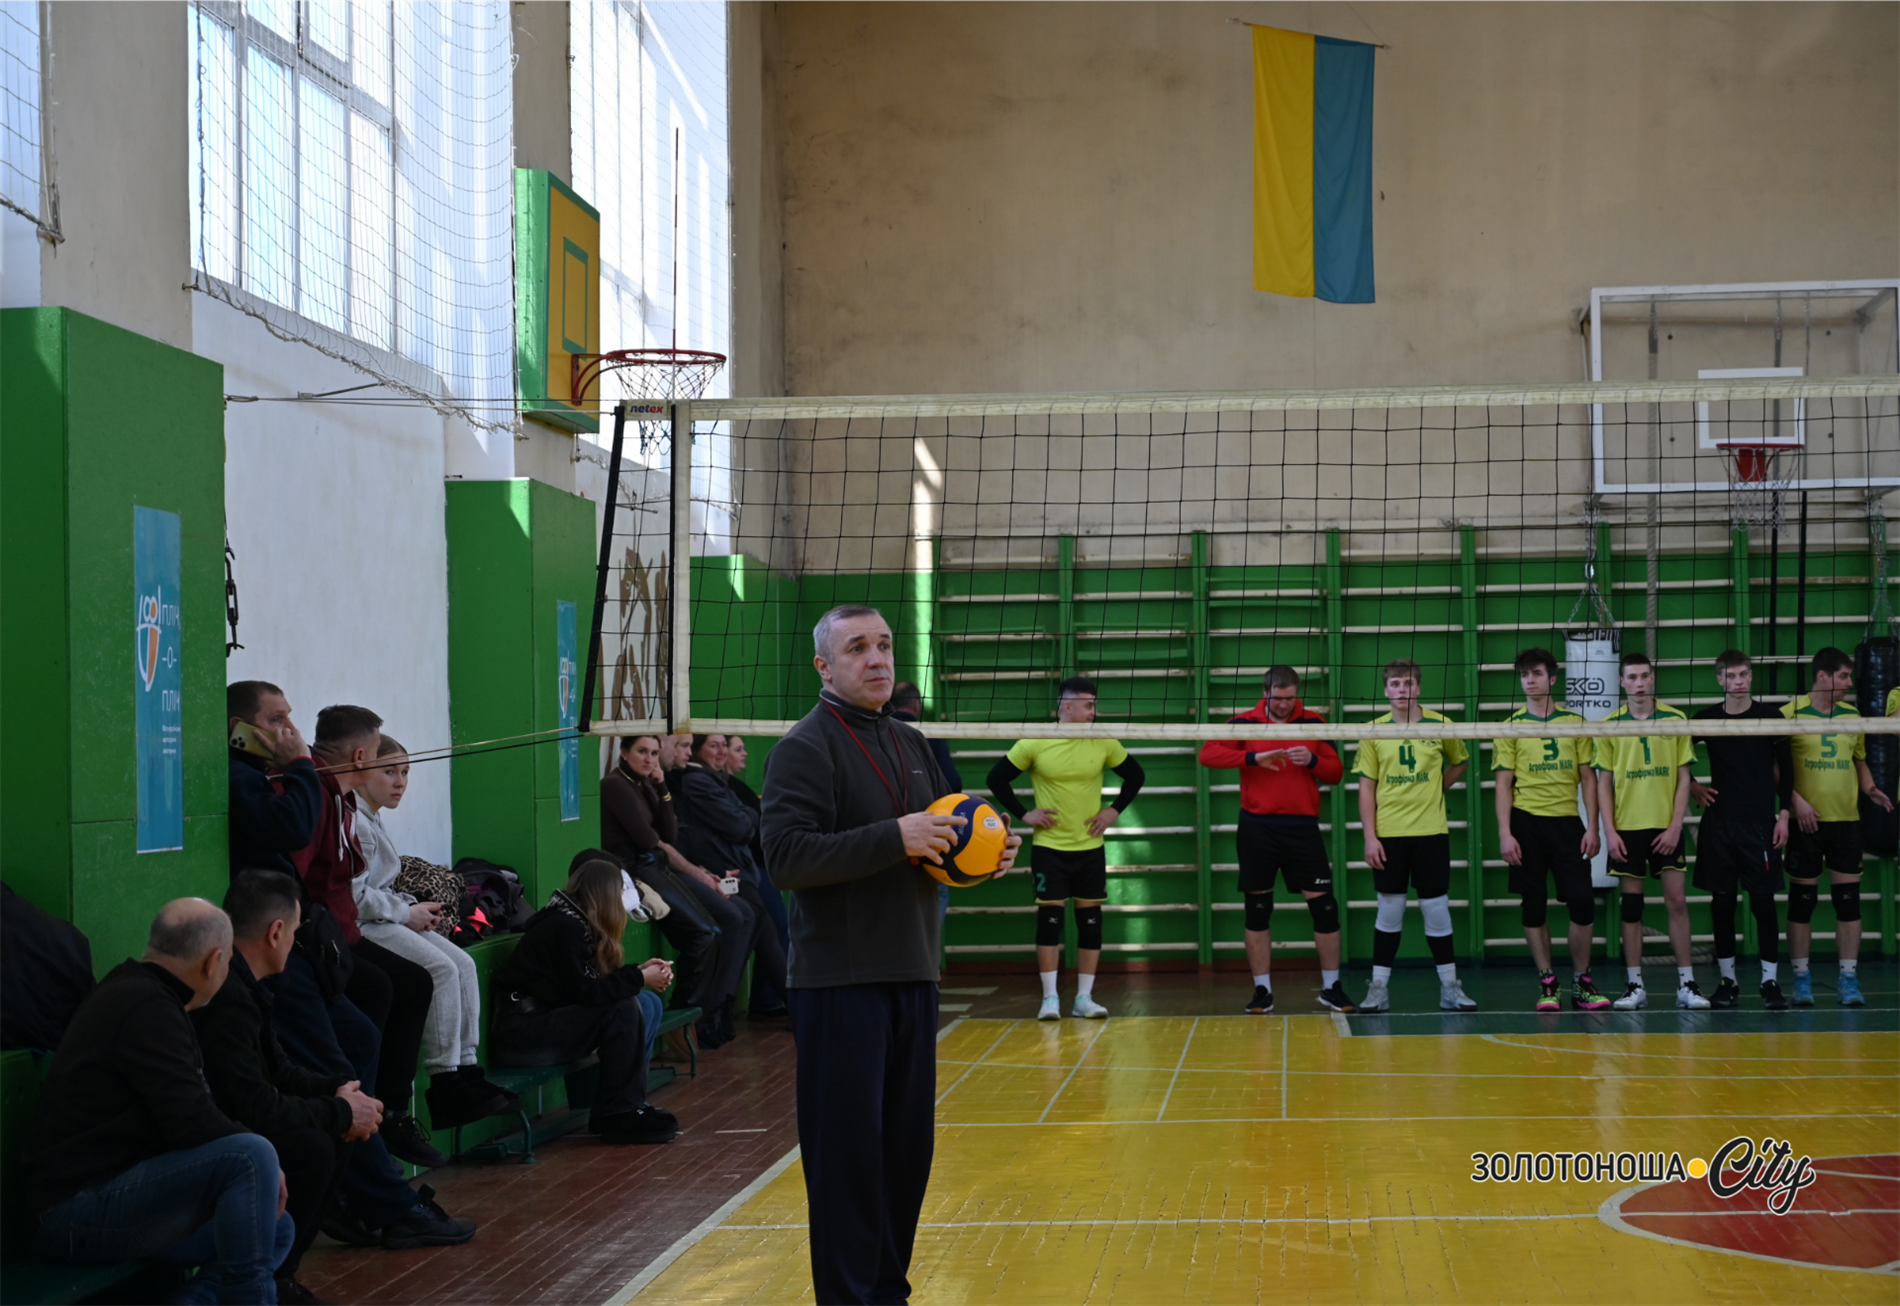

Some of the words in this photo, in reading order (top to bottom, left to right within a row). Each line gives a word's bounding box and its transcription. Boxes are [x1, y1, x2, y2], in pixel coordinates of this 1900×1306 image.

[630, 405, 664, 413] netex
[1541, 737, 1560, 761] 3
[1640, 736, 1651, 765] 1
[1821, 733, 1838, 758] 5
[1399, 745, 1416, 774] 4
[1036, 872, 1046, 892] 2
